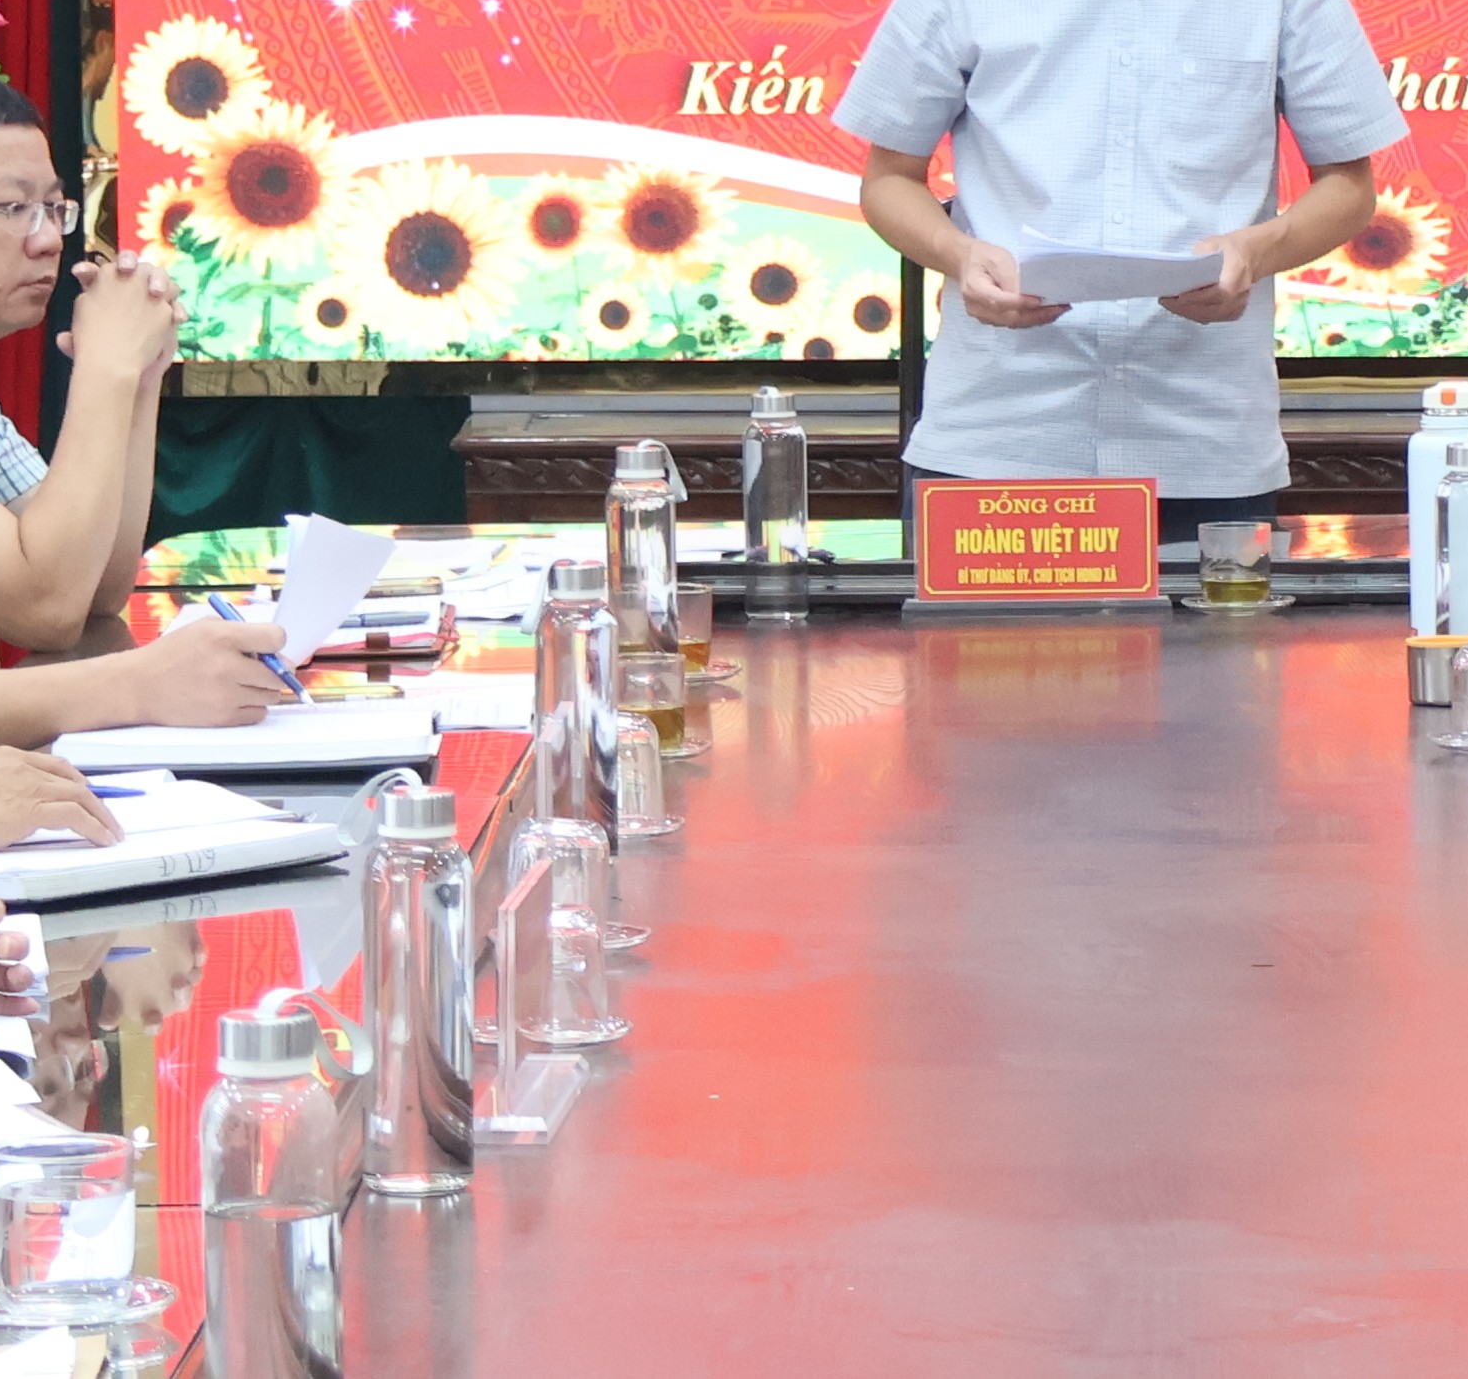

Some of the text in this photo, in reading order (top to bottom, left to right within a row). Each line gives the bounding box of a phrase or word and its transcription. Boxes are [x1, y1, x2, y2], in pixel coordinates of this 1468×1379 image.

[678, 44, 824, 115] Kiến
[978, 491, 1096, 514] ĐỒNG CHÍ
[955, 522, 1119, 558] HOÀNG VIỆT HUY
